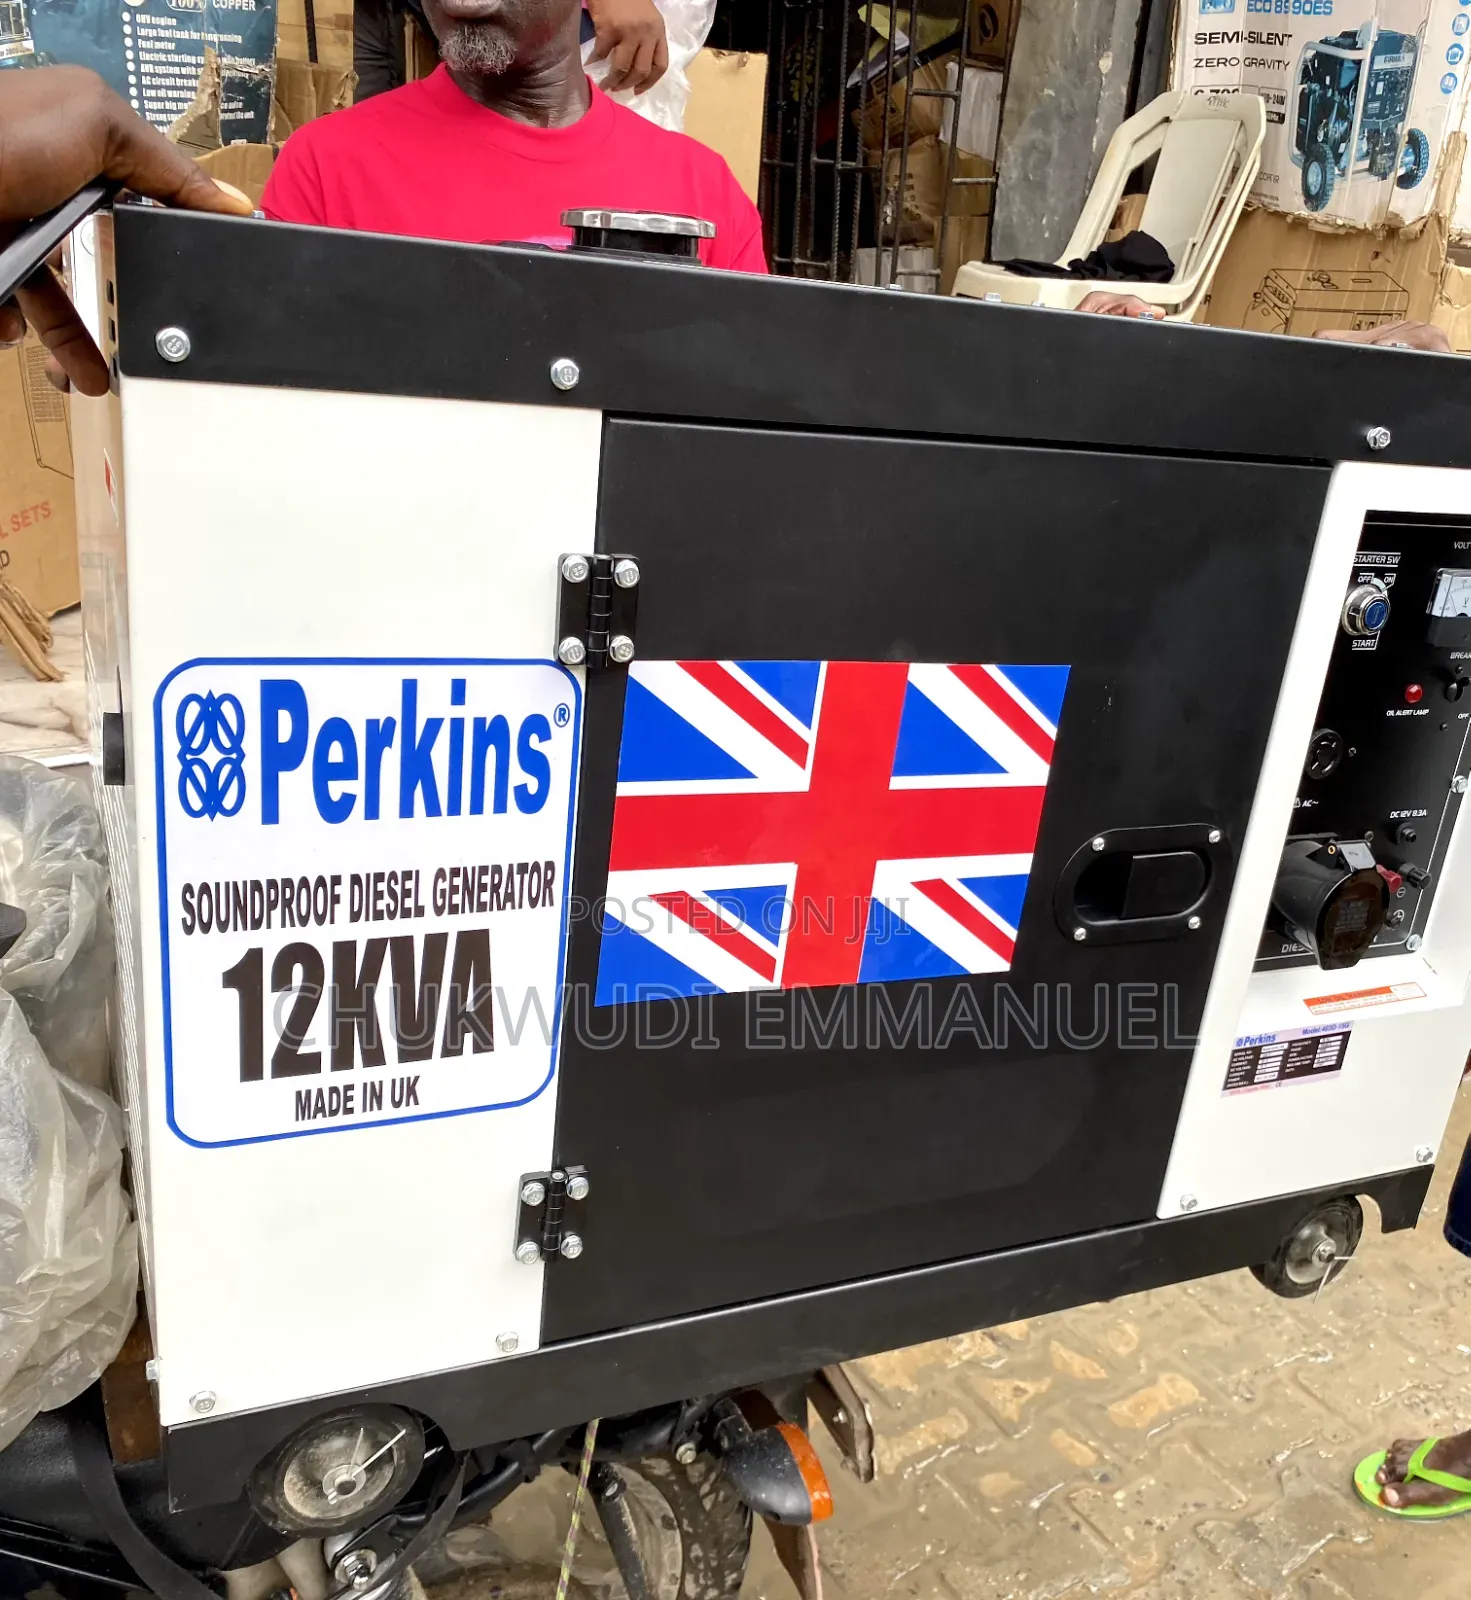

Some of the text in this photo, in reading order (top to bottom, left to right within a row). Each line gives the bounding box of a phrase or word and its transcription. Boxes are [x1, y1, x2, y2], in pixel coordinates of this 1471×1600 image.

[213, 0, 256, 11] COPPER
[1247, 0, 1272, 13] ECO
[151, 16, 177, 26] engine
[136, 26, 157, 38] Large
[157, 27, 173, 38] fuel
[173, 29, 190, 39] tank
[1194, 30, 1293, 47] SEMI-SILENT
[137, 38, 154, 49] Fuel
[139, 51, 167, 63] Electric
[167, 53, 197, 64] starting
[1193, 57, 1290, 70] ZERO GRAVITY
[154, 64, 180, 75] system
[180, 65, 196, 75] with
[141, 75, 151, 85] AC
[151, 76, 175, 86] circuit
[142, 87, 196, 99] Low oil warning
[143, 99, 165, 110] Super
[165, 100, 177, 111] big
[8, 499, 51, 532] SETS
[1353, 555, 1401, 564] STARTER SW
[1358, 575, 1372, 583] OFF
[1352, 639, 1376, 647] START
[1412, 809, 1428, 817] 8.3A
[181, 860, 556, 936] SOUNDPROOF DIESEL GENERATOR
[222, 928, 495, 1083] 12KVA
[1243, 1034, 1276, 1047] Perkins
[295, 1075, 421, 1122] MADE IN UK
